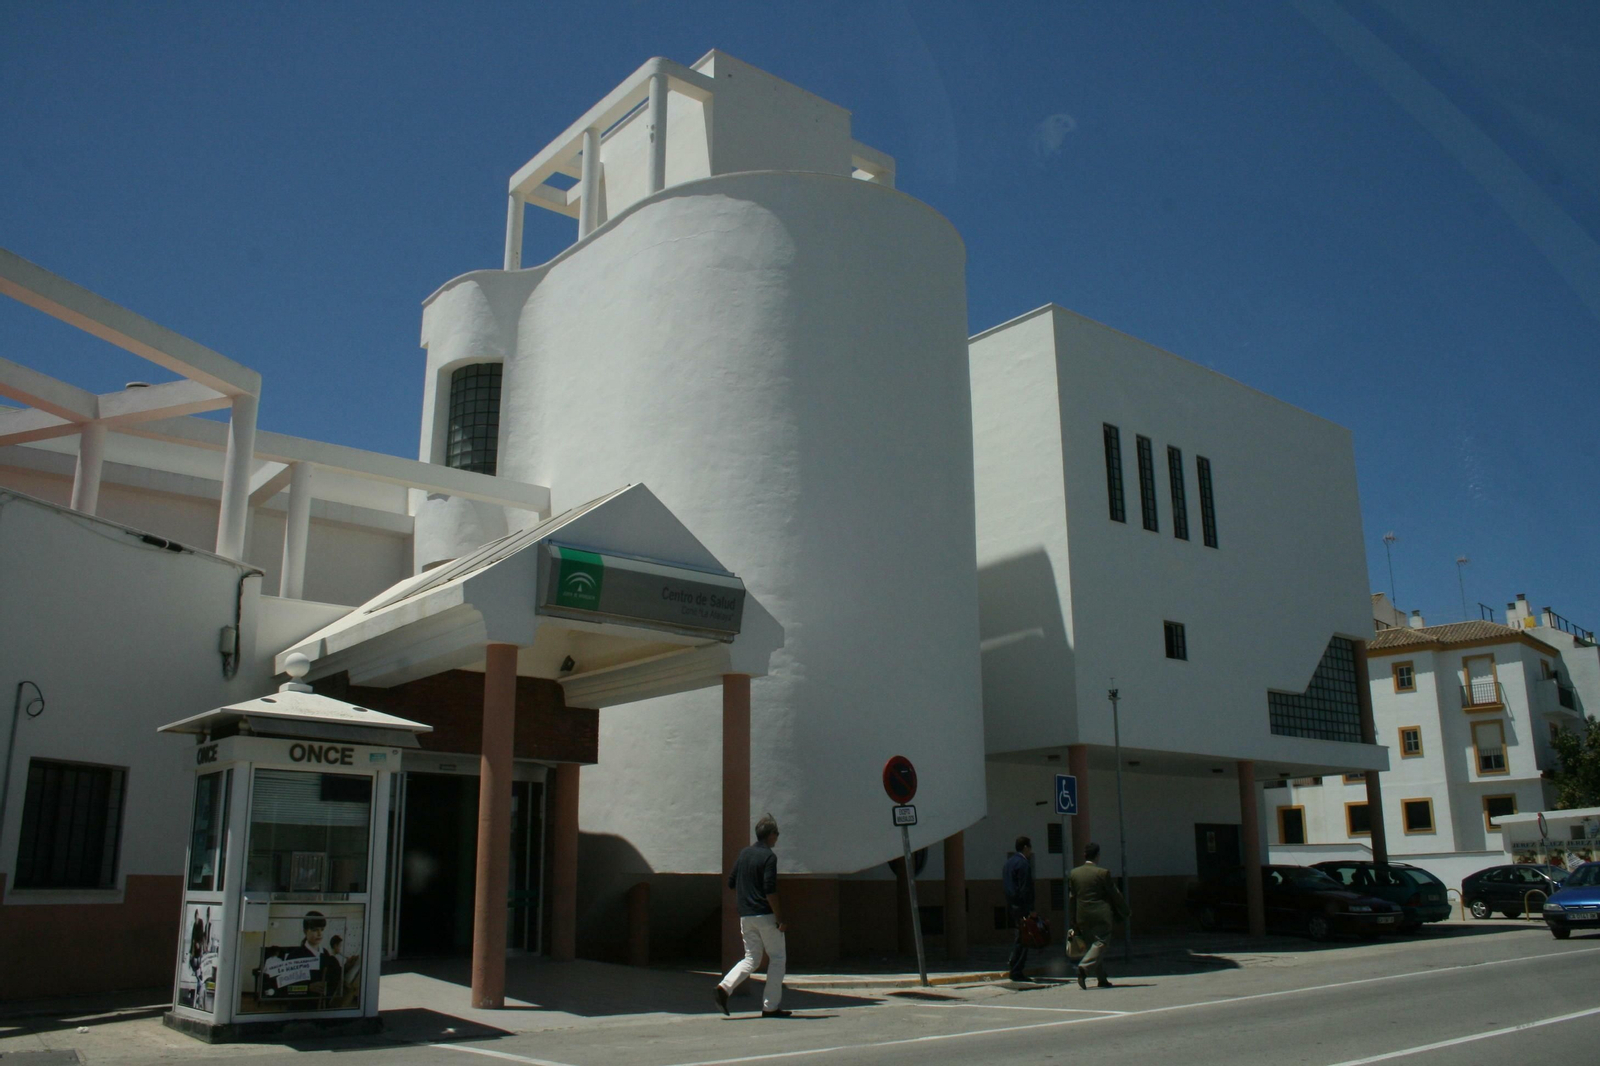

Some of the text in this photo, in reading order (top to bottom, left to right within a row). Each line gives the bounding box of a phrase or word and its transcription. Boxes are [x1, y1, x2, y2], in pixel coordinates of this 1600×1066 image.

[662, 587, 736, 611] Centro de Salud
[196, 743, 218, 765] ONCE
[289, 743, 354, 765] ONCE
